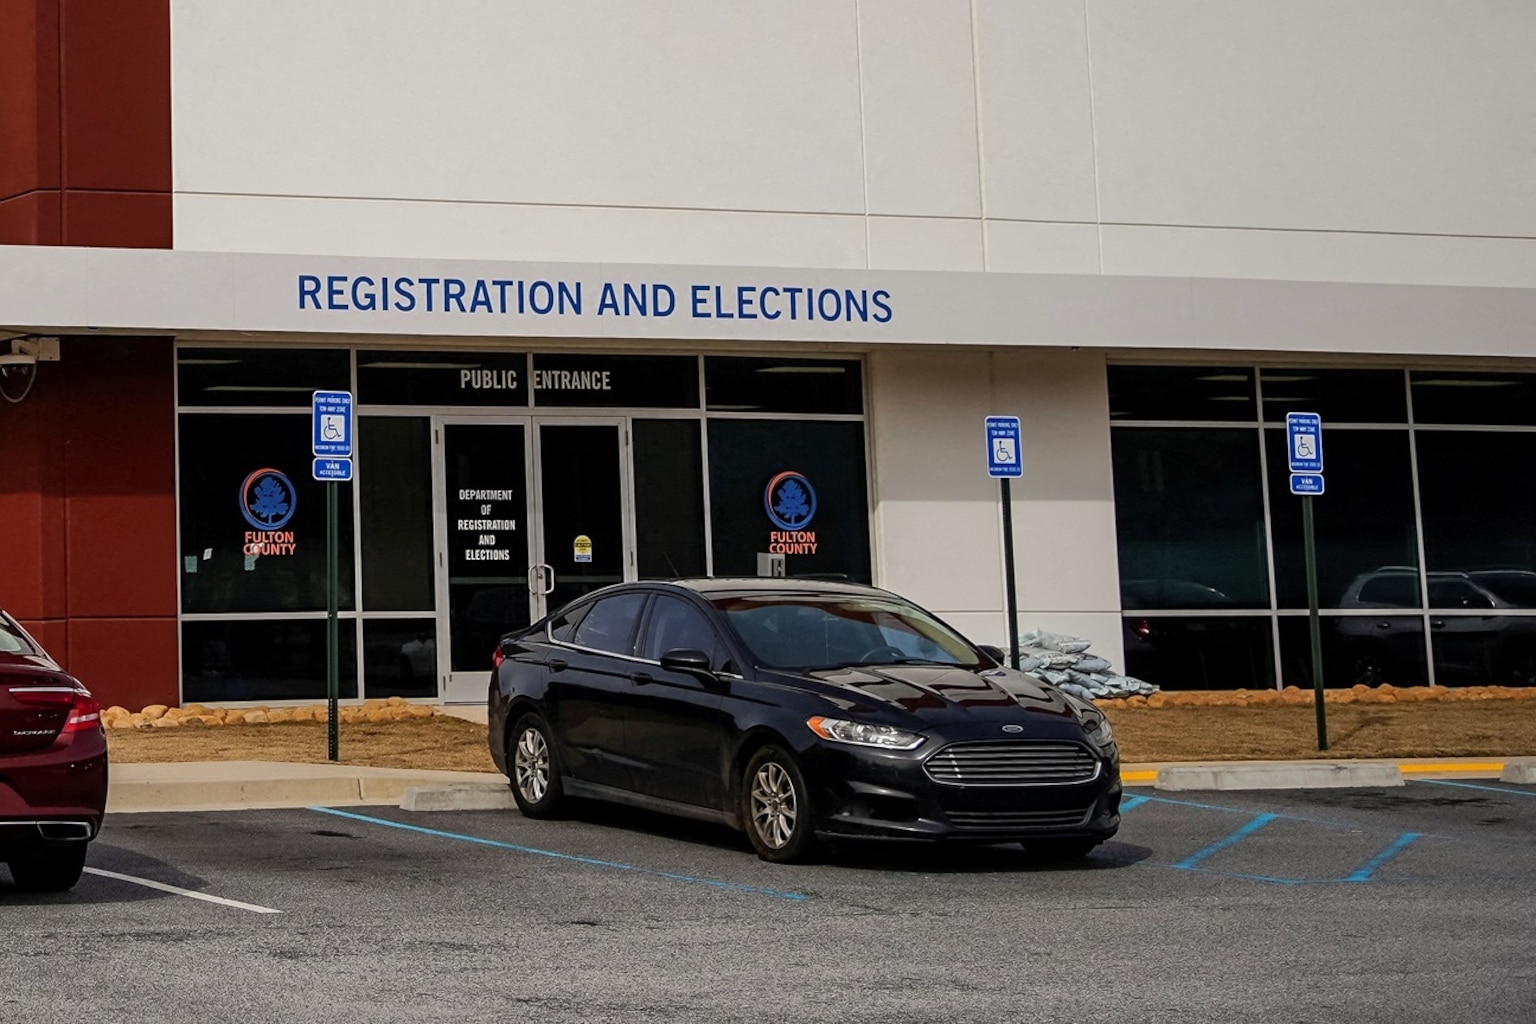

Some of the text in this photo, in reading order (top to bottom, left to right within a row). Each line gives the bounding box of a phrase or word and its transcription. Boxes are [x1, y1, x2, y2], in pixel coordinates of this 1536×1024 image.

[298, 274, 893, 324] REGISTRATION AND ELECTIONS
[460, 370, 612, 390] PUBLIC ENTRANCE
[325, 462, 340, 470] VAN
[458, 489, 513, 501] DEPARTMENT
[480, 504, 492, 516] OF
[457, 519, 516, 531] REGISTRATION
[244, 531, 294, 543] FULTON
[478, 534, 496, 546] AND
[770, 531, 816, 543] FULTON
[242, 543, 297, 556] COUNTY
[465, 549, 510, 561] ELECTIONS
[769, 543, 818, 555] COUNTY
